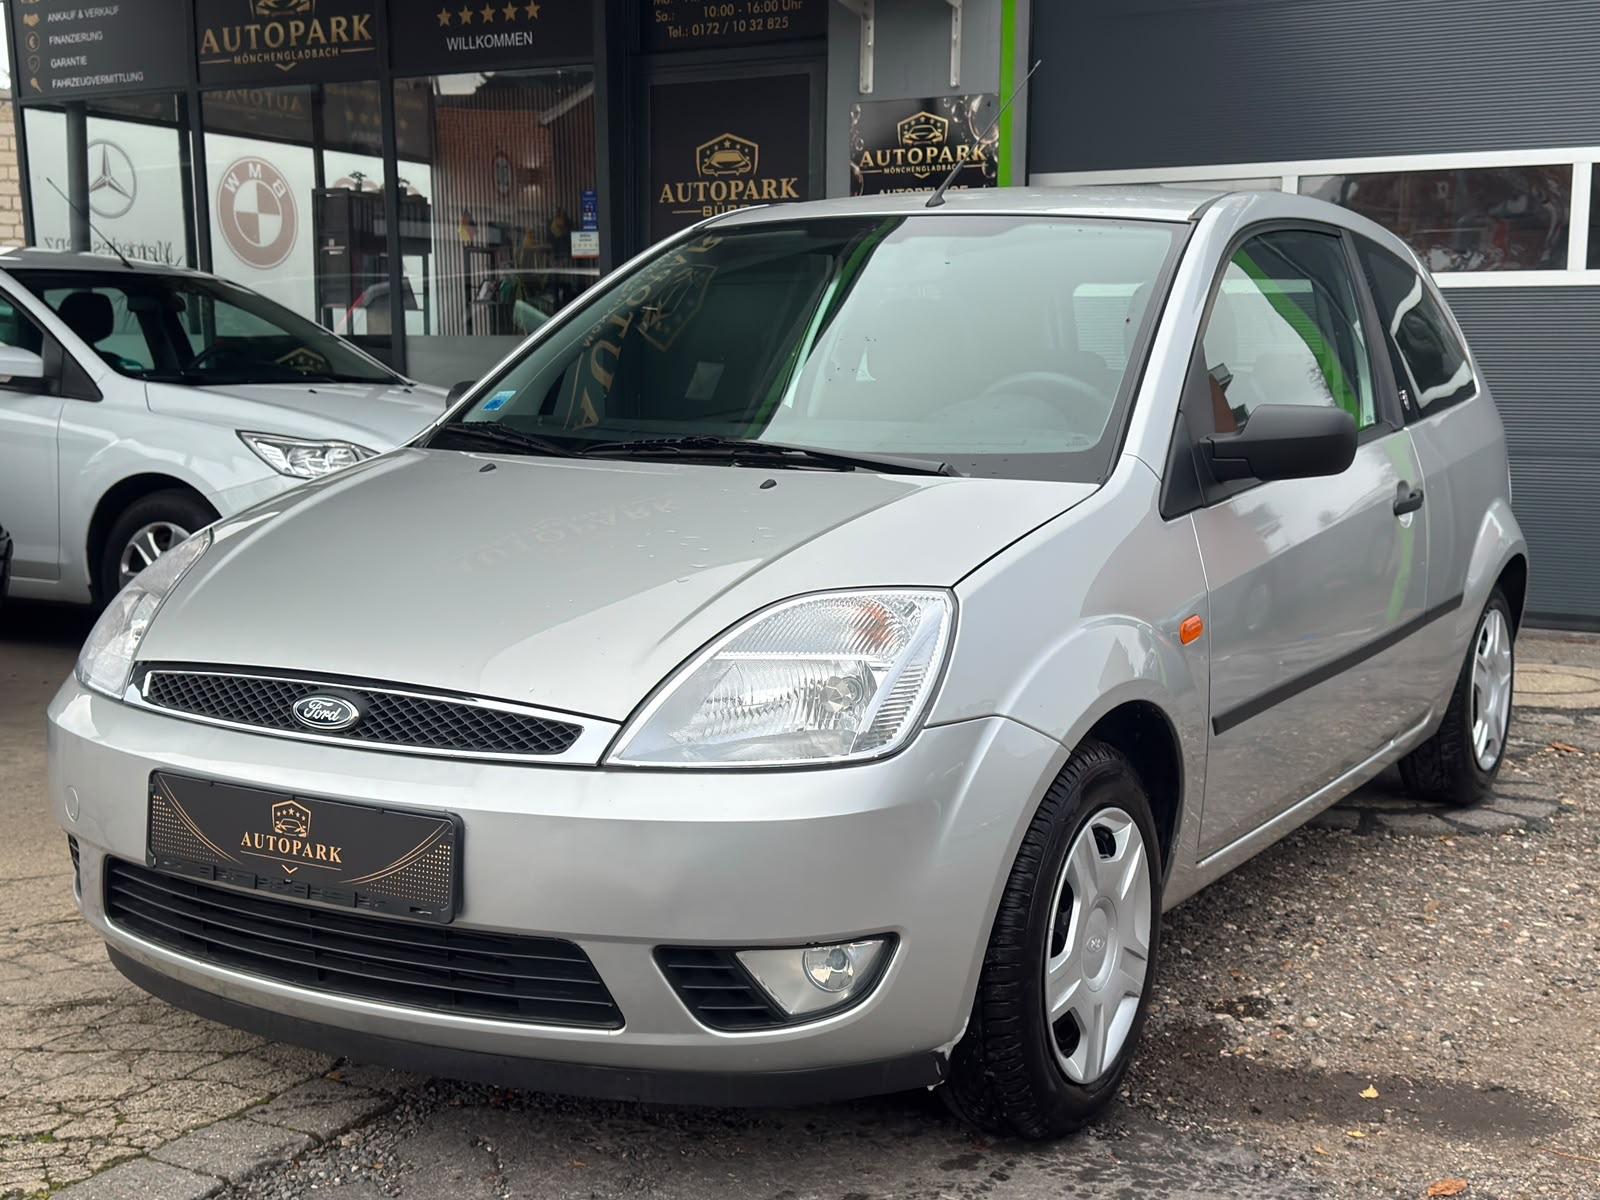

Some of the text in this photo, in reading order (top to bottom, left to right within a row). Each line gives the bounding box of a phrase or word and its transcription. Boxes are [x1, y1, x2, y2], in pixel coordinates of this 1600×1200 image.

[47, 5, 120, 22] ANKAUF & VERKAUF
[703, 5, 735, 18] 10:00
[747, 1, 779, 14] 16:00
[201, 13, 373, 55] AUTOPARK
[668, 16, 789, 38] Tel.: 0172 / 10 32 825
[49, 31, 103, 45] FINANZIERUNG
[446, 31, 534, 52] WILLKOMMEN
[51, 55, 87, 68] GARANTIE
[233, 47, 339, 65] MÖNCHENGLADBACH
[52, 71, 144, 89] FAHRZEUGVERMITTLUNG
[860, 143, 988, 167] AUTOPARK
[884, 164, 957, 175] MÖNCHENGLADBAC
[660, 177, 799, 204] AUTOPARK
[303, 700, 342, 721] Ford
[240, 830, 343, 864] AUTOPARK
